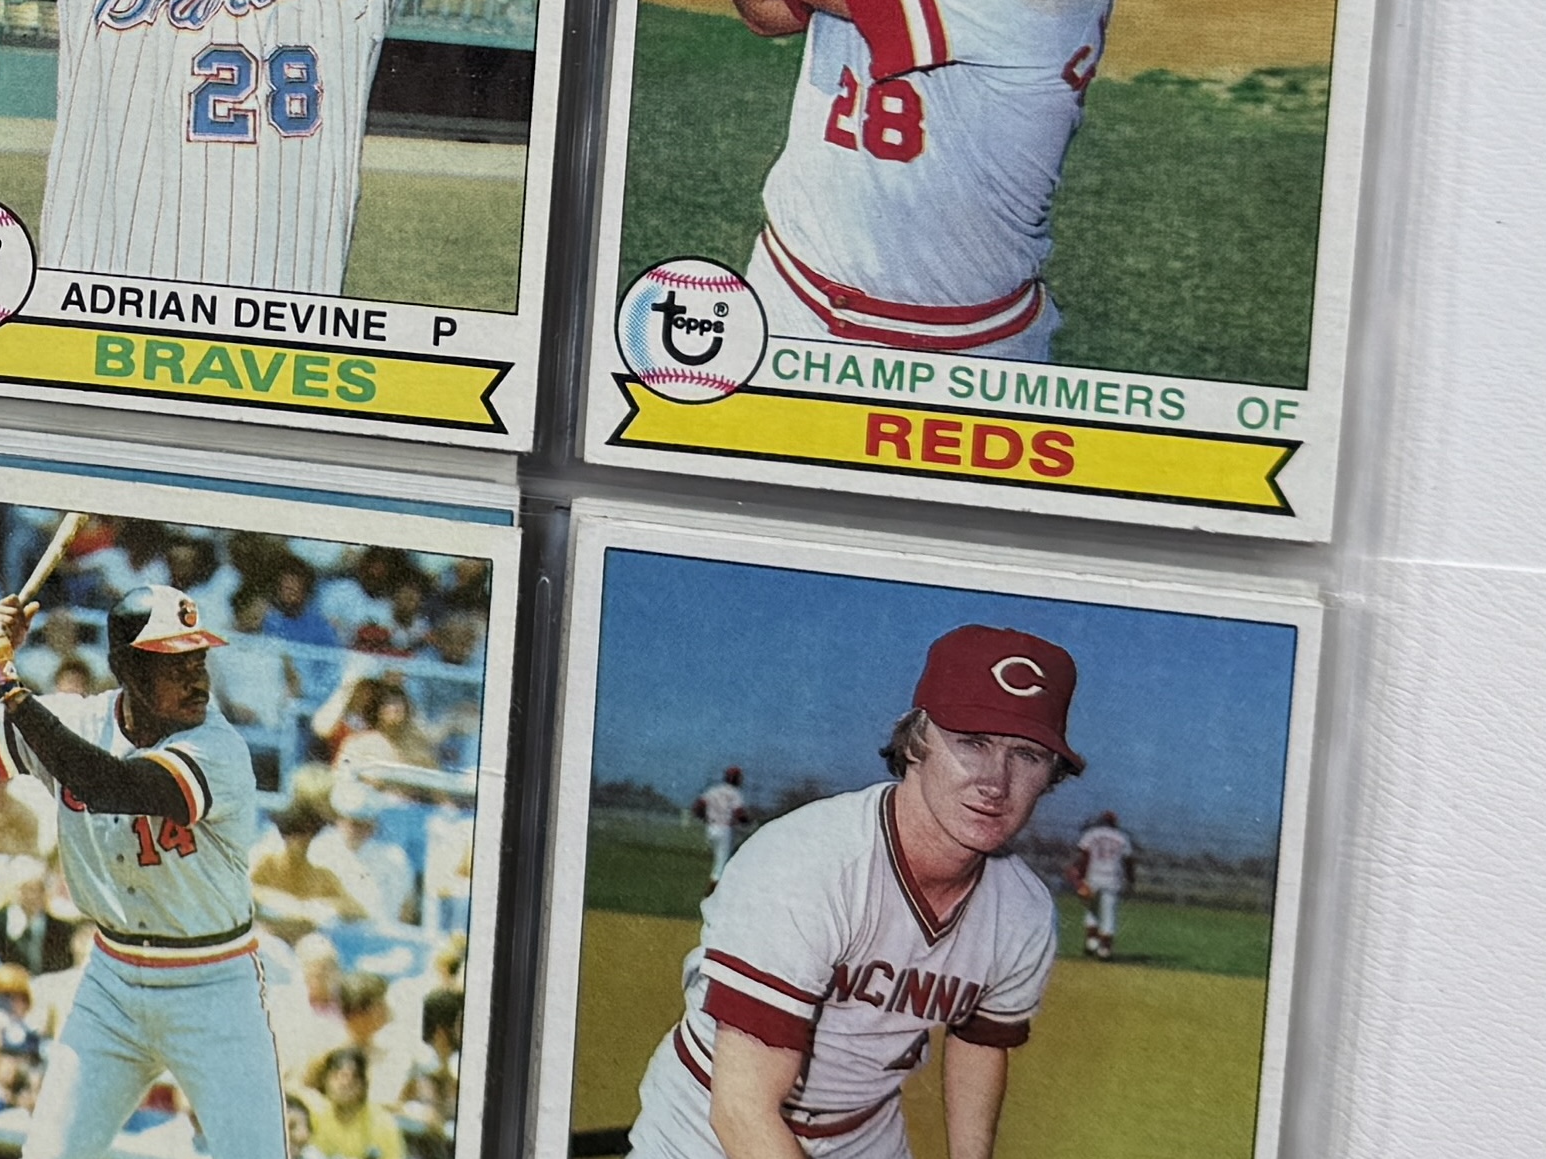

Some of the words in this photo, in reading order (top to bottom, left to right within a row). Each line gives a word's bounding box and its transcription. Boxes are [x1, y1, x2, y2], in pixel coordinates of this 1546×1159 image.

[187, 43, 323, 144] 28
[825, 65, 926, 162] 28
[61, 283, 218, 326] ADRIAN
[235, 300, 388, 342] DEVINE
[433, 318, 457, 346] P
[651, 291, 726, 367] topps
[95, 335, 377, 402] BRAVES
[771, 349, 935, 391] CHAMP
[948, 367, 1186, 420] SUMMERS
[1238, 397, 1299, 430] OF
[865, 413, 1075, 477] REDS
[991, 656, 1047, 697] C
[132, 815, 197, 867] 14
